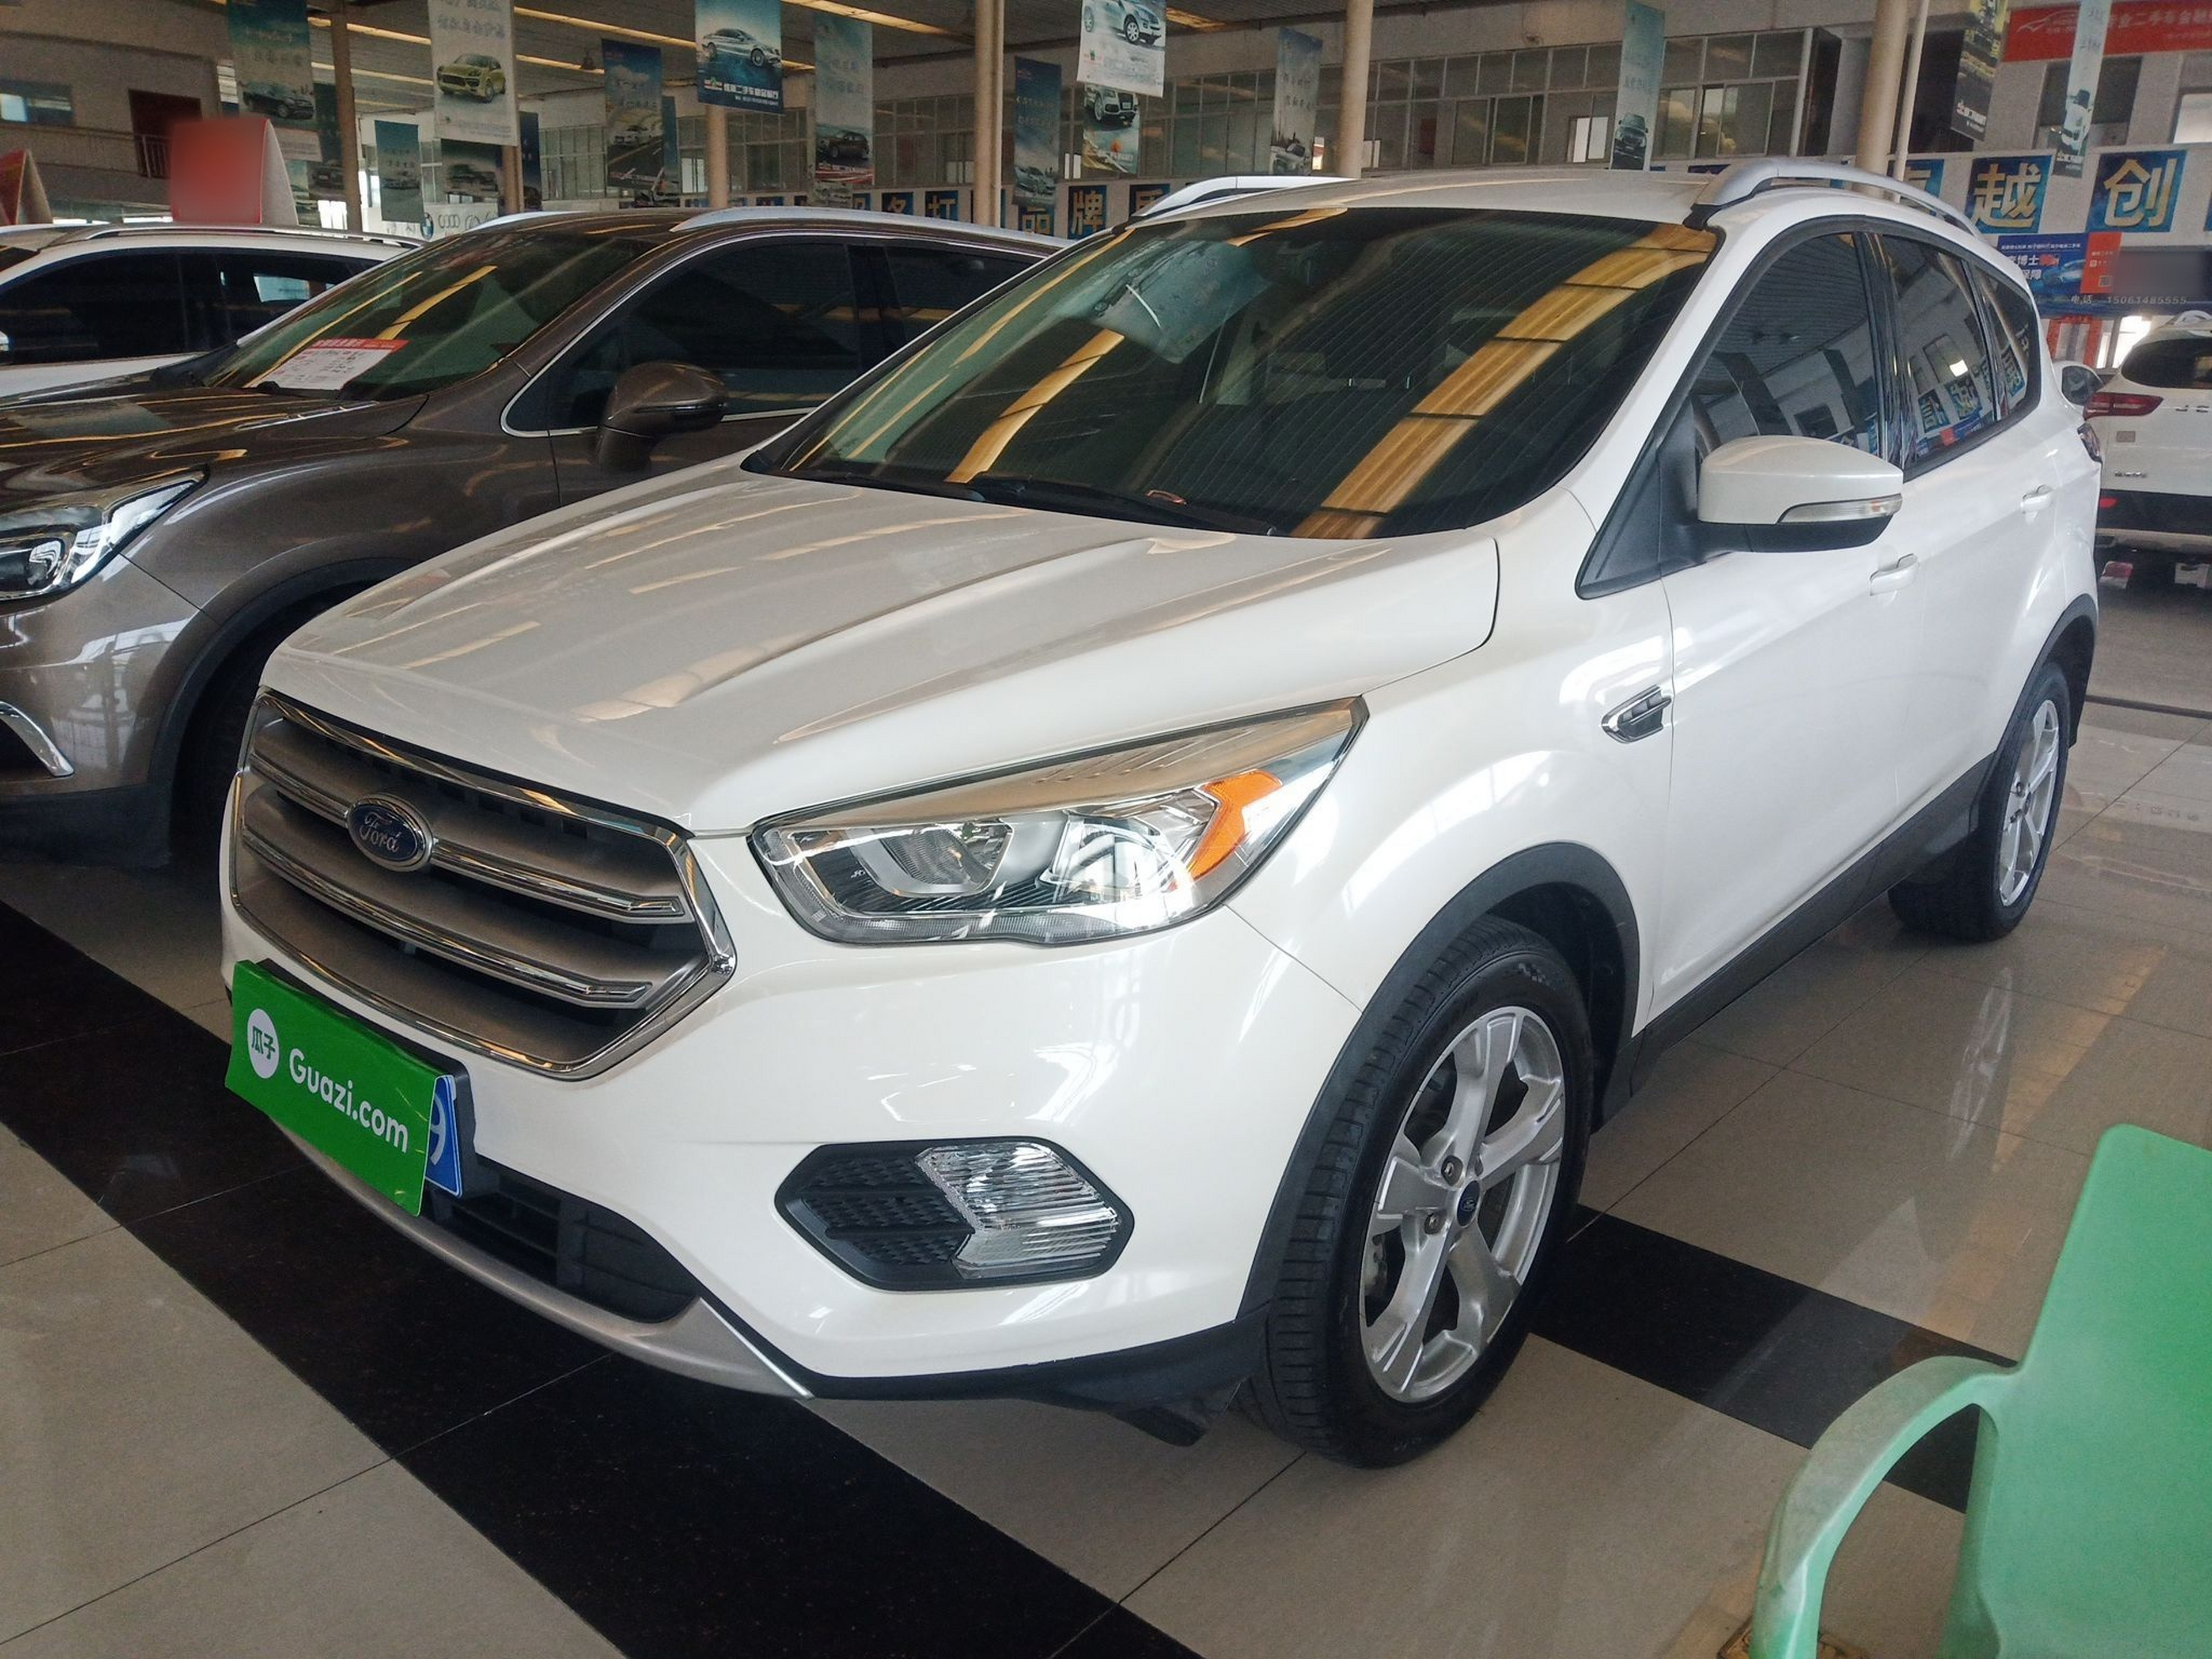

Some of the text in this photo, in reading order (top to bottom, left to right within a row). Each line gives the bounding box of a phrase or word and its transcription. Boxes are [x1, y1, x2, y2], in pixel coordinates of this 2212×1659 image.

[359, 811, 402, 853] Ford
[251, 1025, 276, 1060] 瓜子
[289, 1048, 409, 1153] Guazi.com
